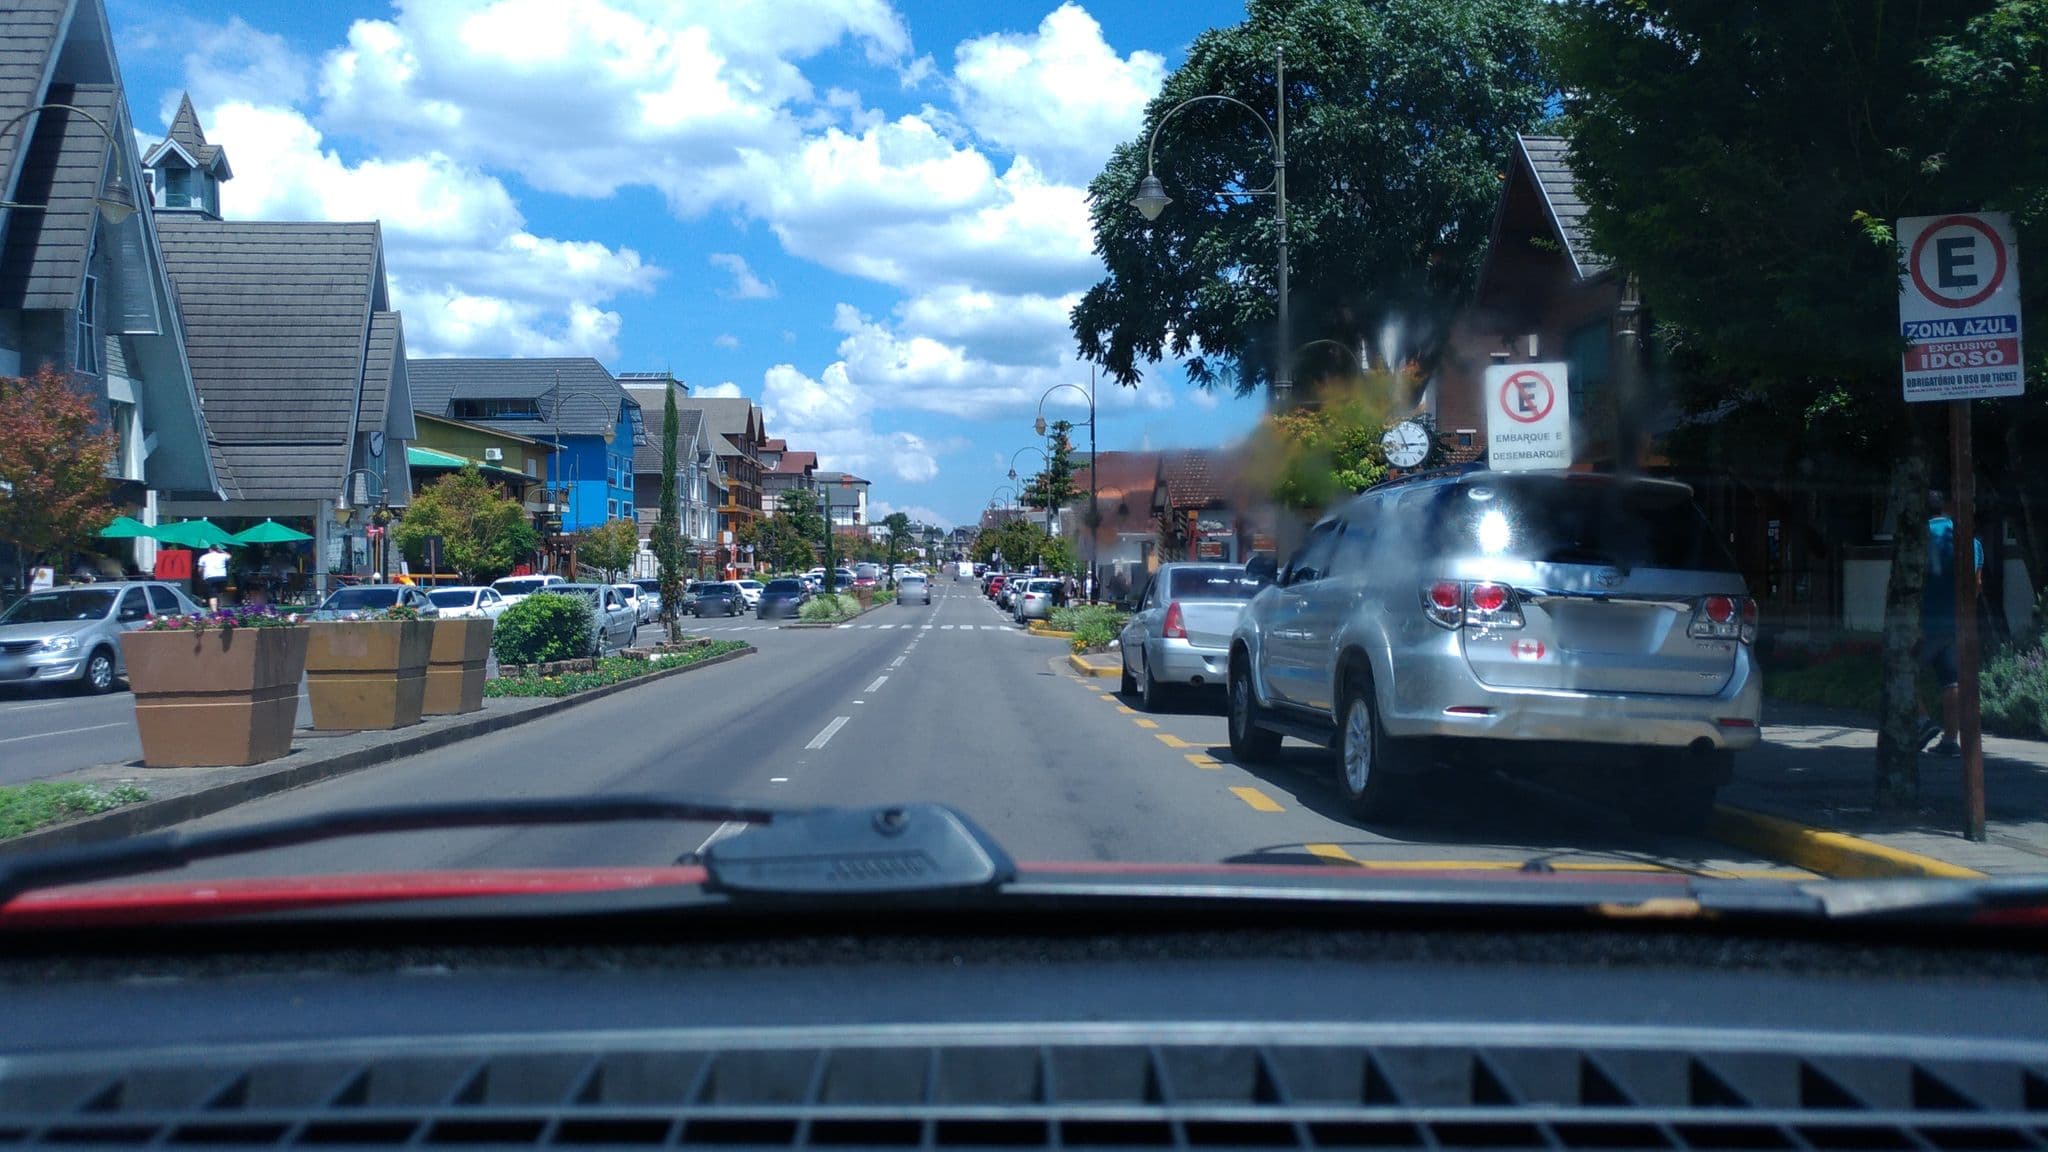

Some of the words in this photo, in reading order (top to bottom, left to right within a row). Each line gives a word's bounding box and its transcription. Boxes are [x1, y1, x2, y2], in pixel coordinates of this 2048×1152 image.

[1936, 236, 1978, 289] E
[1907, 321, 1959, 338] ZONA
[1963, 318, 2011, 335] AZUL
[1928, 340, 1997, 353] EXCLUSIVO
[1921, 350, 2004, 369] IDOSO
[1906, 373, 1956, 388] OBRIGATÓRIO
[1956, 374, 1963, 385] O
[1964, 374, 1979, 385] USO
[1980, 373, 1991, 383] DO
[1992, 371, 2017, 382] TICKET
[1517, 381, 1537, 413] E
[1495, 432, 1551, 443] EMBARQUE
[1555, 432, 1563, 440] E
[1493, 448, 1567, 461] DESEMBARQUE
